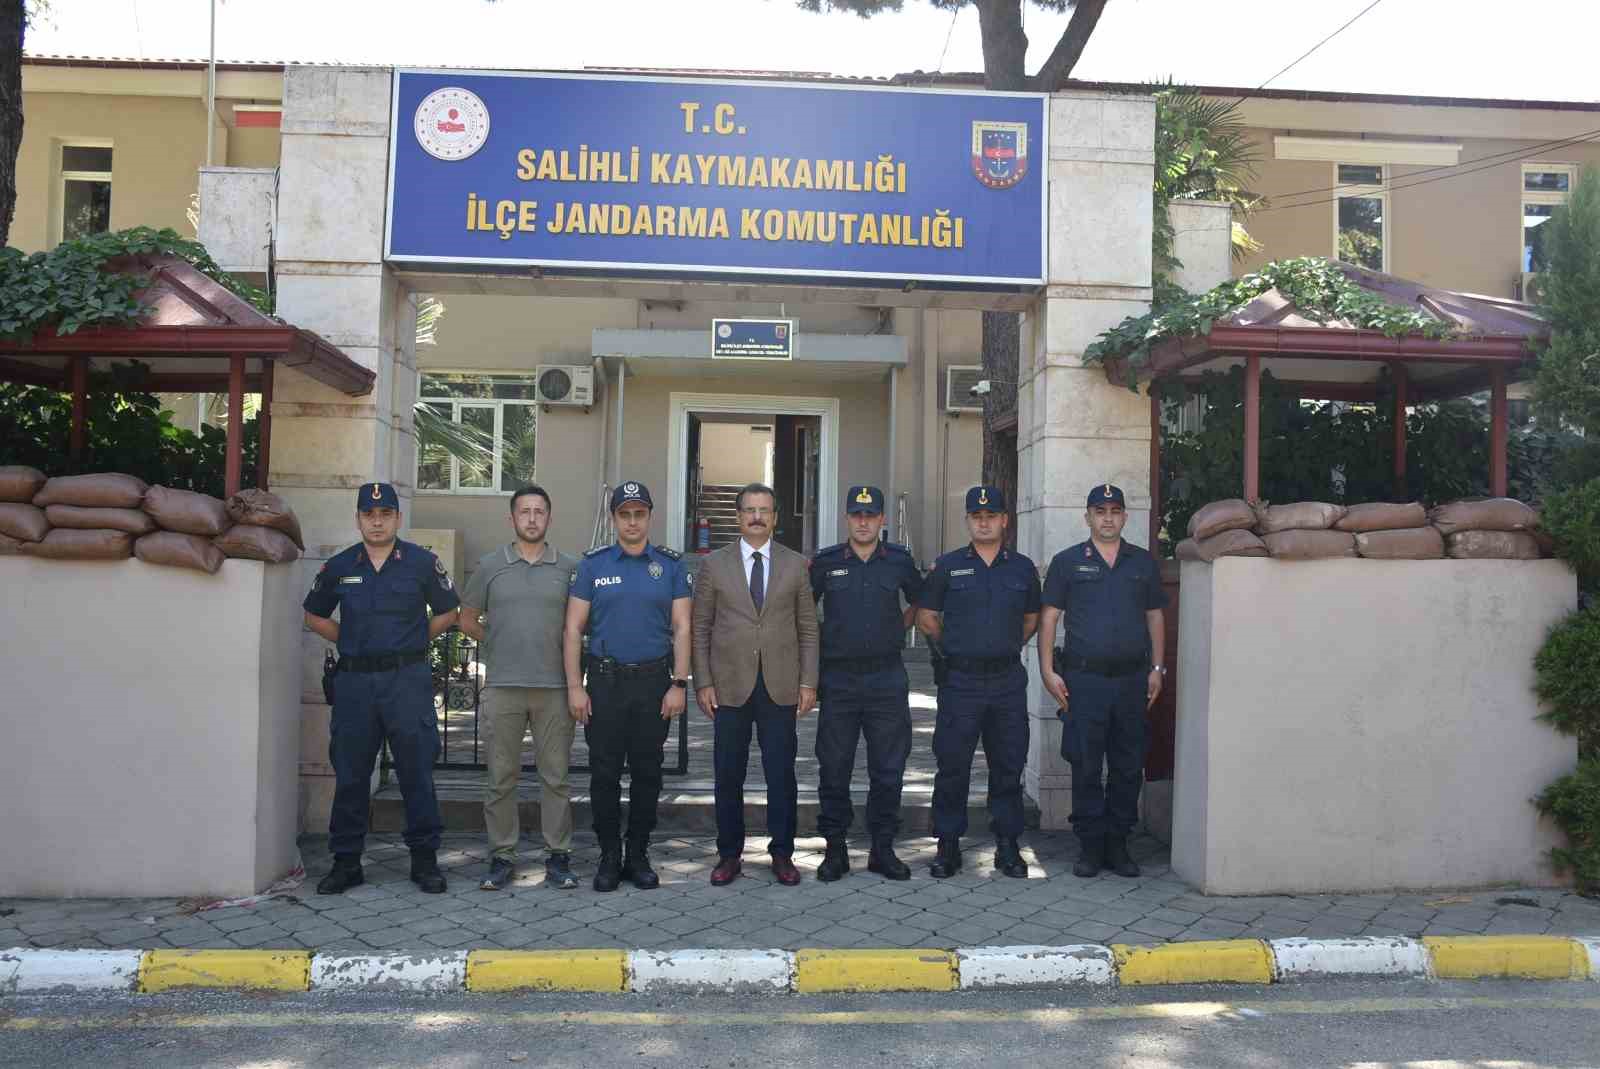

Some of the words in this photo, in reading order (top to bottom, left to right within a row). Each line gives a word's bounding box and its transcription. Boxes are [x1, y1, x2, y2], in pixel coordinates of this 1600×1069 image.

[516, 145, 639, 183] SALİHLİ
[652, 152, 906, 193] KAYMAKAMLIĞI
[466, 192, 537, 240] İLÇE
[547, 201, 729, 239] JANDARMA
[740, 207, 965, 249] KOMUTANLIĞI
